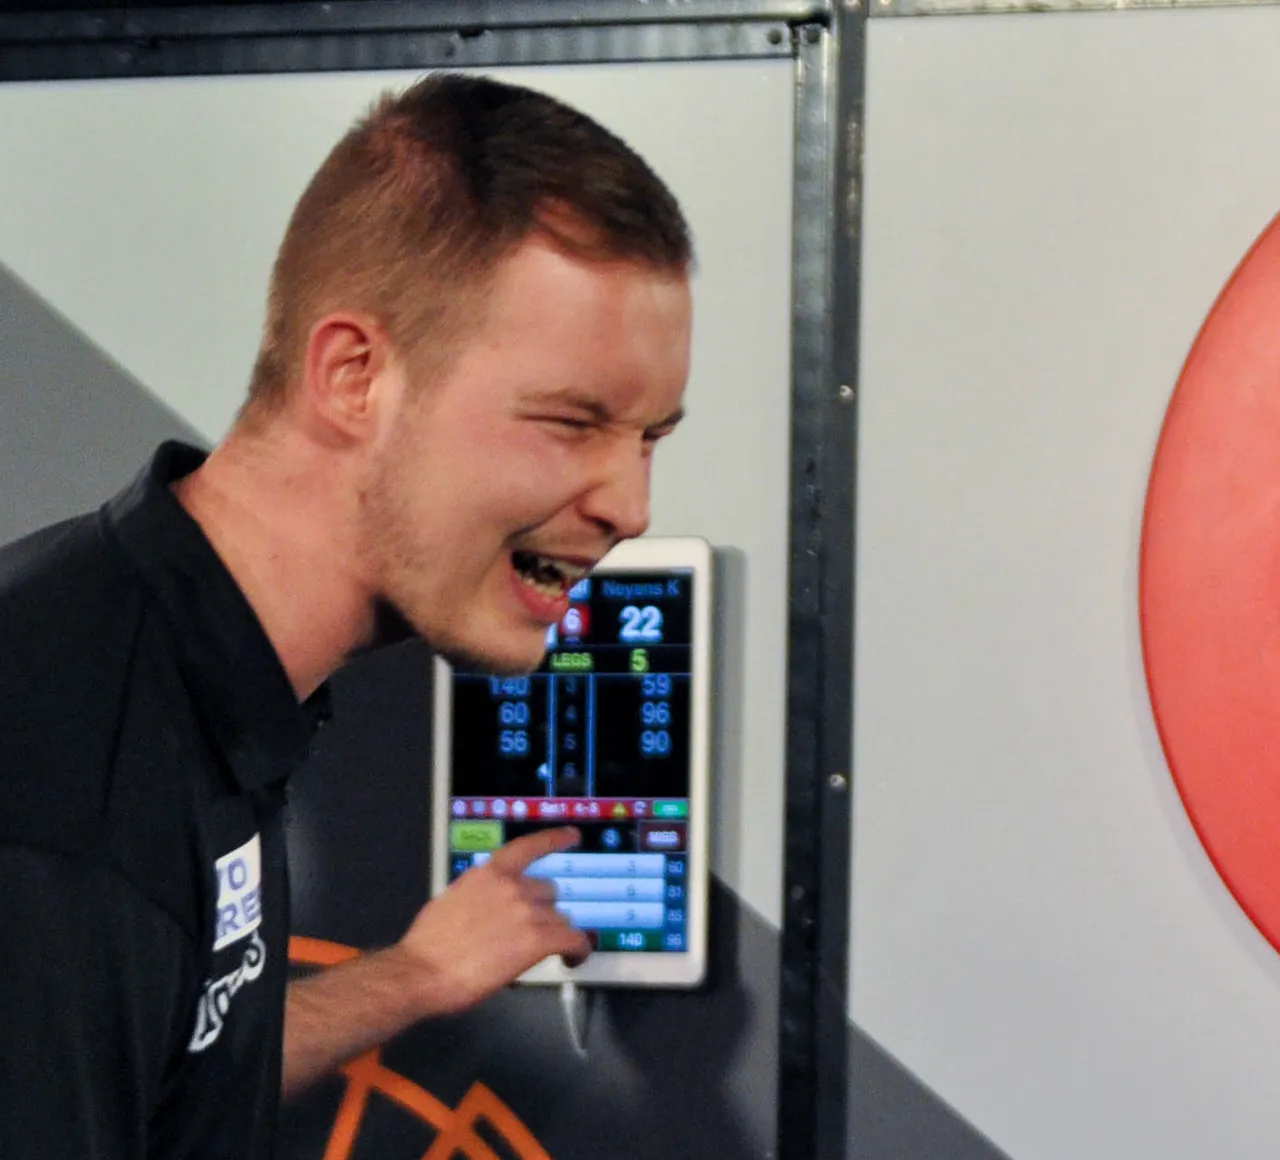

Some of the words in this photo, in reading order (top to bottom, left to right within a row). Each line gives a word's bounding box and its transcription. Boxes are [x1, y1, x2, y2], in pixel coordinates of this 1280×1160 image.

[666, 579, 680, 596] K
[620, 604, 663, 643] 22
[552, 652, 593, 670] LEGS
[630, 648, 649, 674] 5
[641, 675, 671, 696] 59
[500, 701, 528, 724] 60
[641, 701, 670, 724] 96
[500, 730, 528, 752] 56
[641, 730, 670, 753] 90
